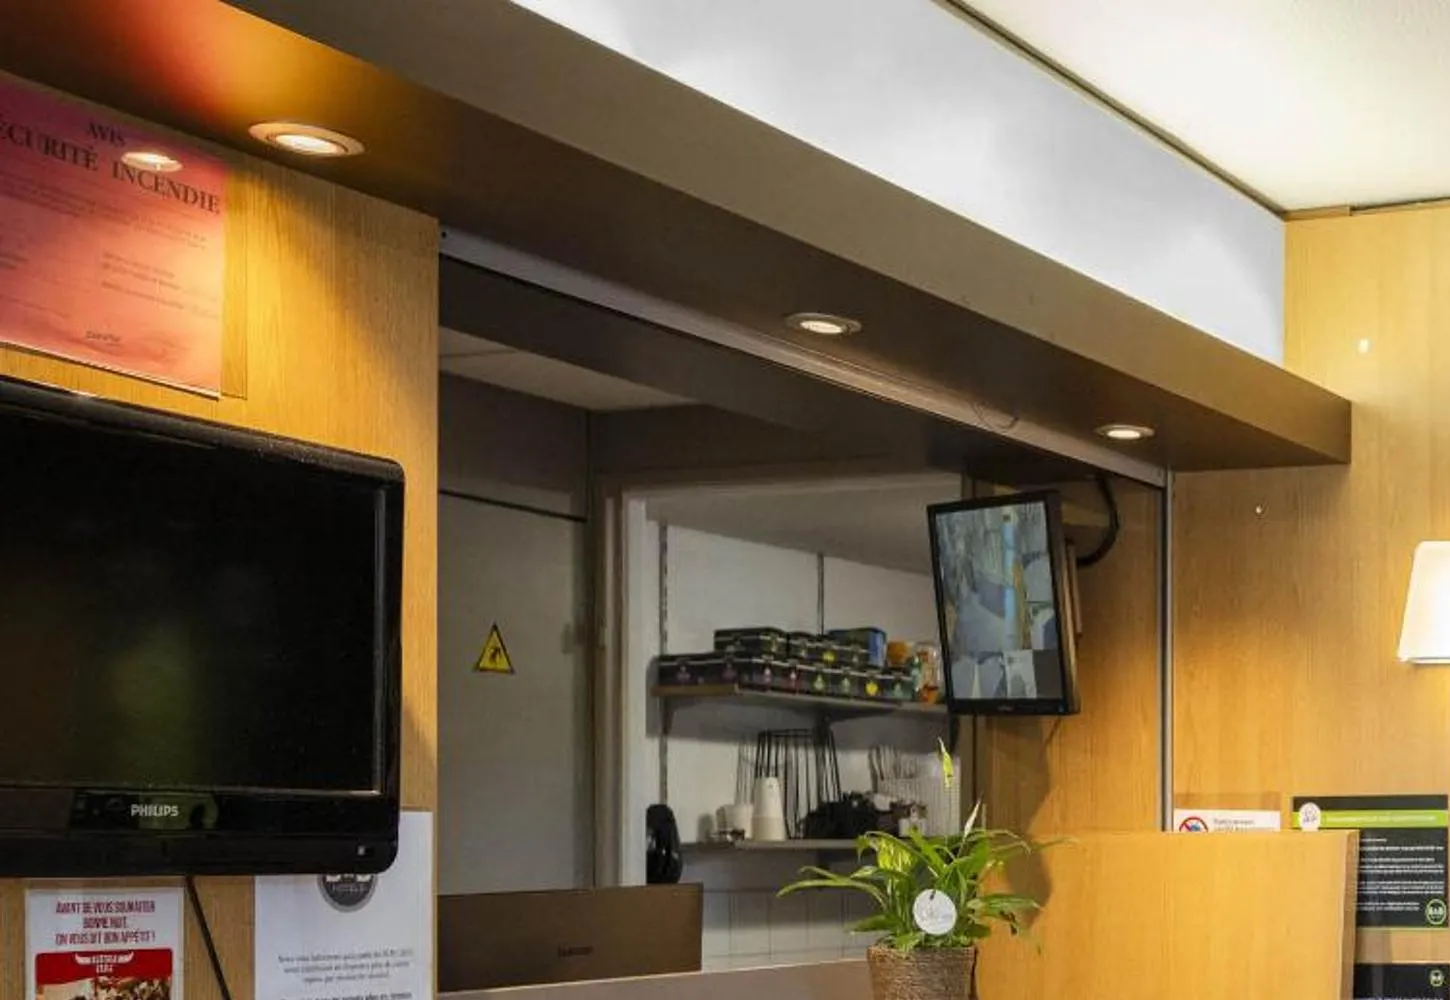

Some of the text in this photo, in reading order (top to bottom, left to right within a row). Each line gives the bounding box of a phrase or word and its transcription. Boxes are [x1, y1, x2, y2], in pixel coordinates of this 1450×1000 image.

[86, 119, 126, 149] AVIS
[111, 160, 220, 215] INCENDIE
[130, 793, 180, 807] PHILIPS
